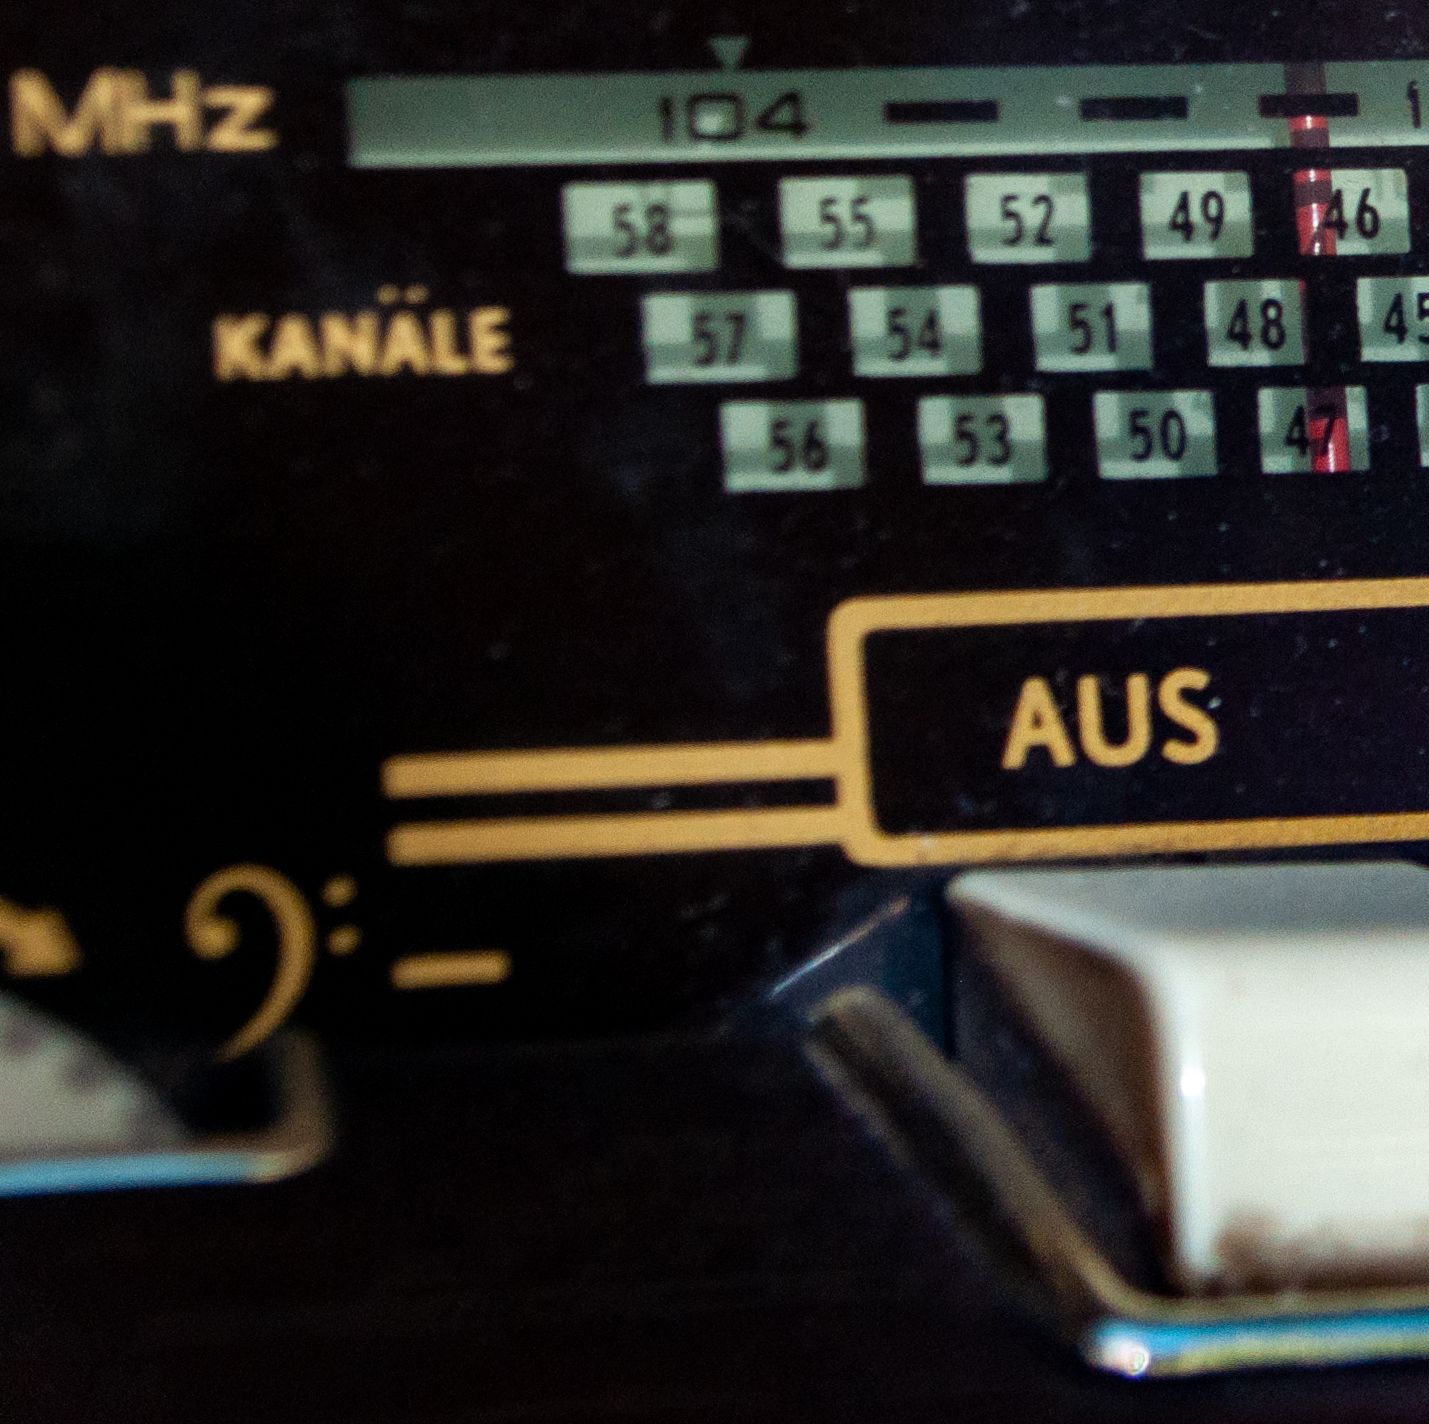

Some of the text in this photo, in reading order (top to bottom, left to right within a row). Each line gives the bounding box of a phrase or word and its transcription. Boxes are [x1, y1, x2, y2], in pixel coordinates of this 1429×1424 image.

[7, 66, 278, 159] MHz
[658, 91, 808, 143] 104
[612, 203, 675, 259] 58
[819, 197, 876, 250] 55
[1002, 194, 1057, 248] 52
[1168, 191, 1225, 243] 49
[1325, 187, 1380, 239] 46
[212, 283, 515, 382] KANÄLE
[691, 313, 747, 369] 57
[887, 306, 943, 363] 54
[1068, 302, 1118, 357] 51
[1226, 297, 1287, 350] 48
[768, 418, 829, 473] 56
[954, 412, 1013, 466] 53
[1129, 409, 1187, 463] 50
[1001, 667, 1220, 769] AUS
